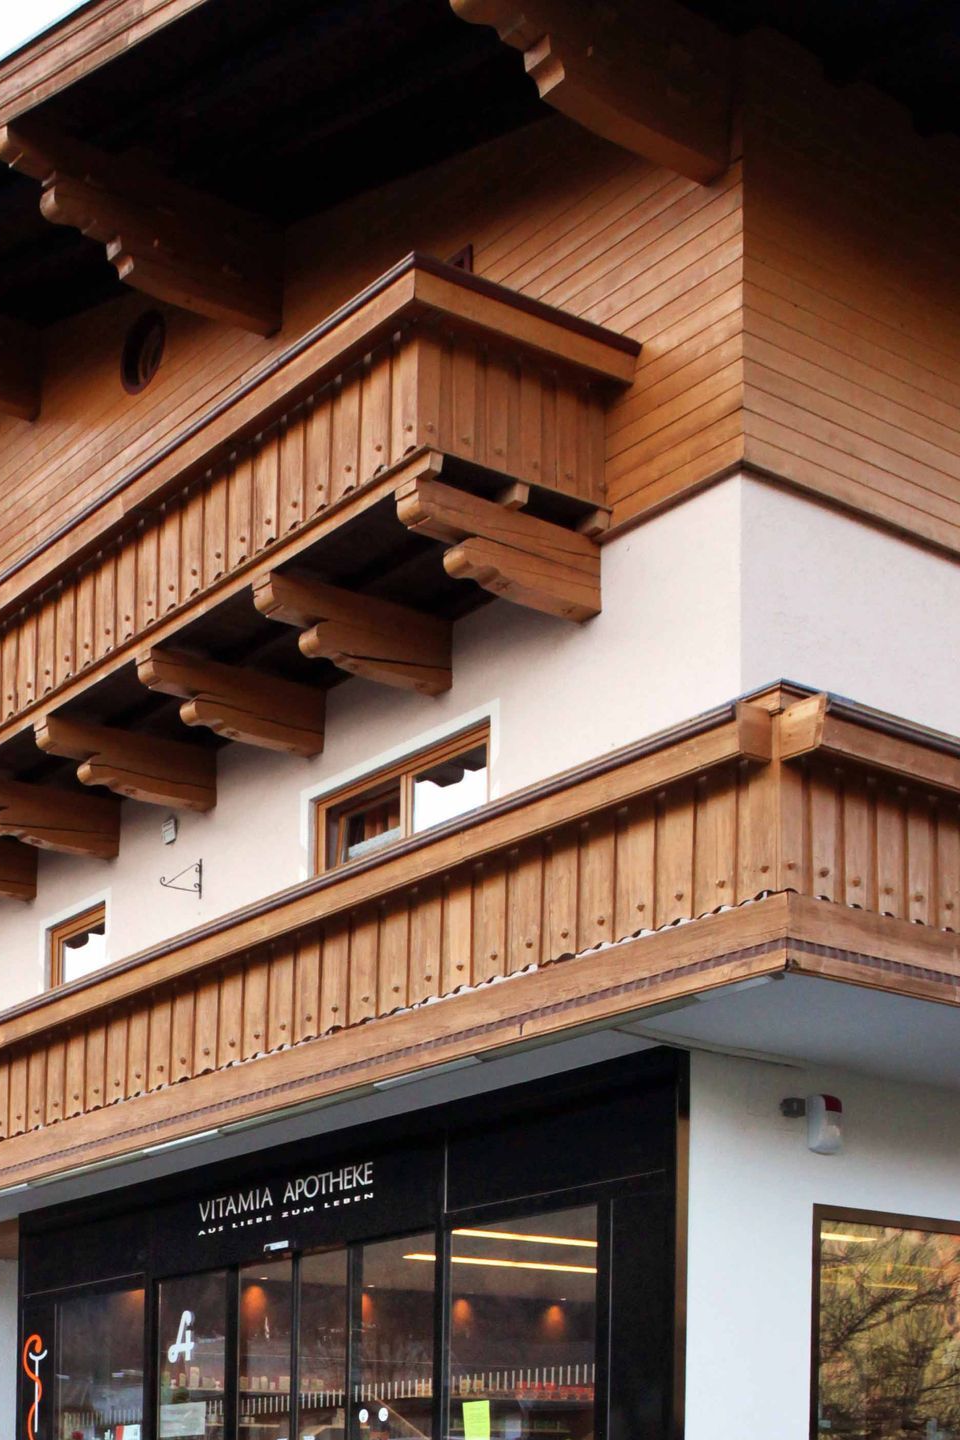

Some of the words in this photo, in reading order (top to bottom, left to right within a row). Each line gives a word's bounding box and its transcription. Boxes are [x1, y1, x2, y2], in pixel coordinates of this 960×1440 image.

[198, 1187, 273, 1222] VITAMIA
[283, 1162, 374, 1204] APOTHEKE
[198, 1225, 224, 1236] AUS
[232, 1214, 273, 1229] LIEBE
[281, 1205, 315, 1218] ZUM
[324, 1192, 374, 1209] LEBEN
